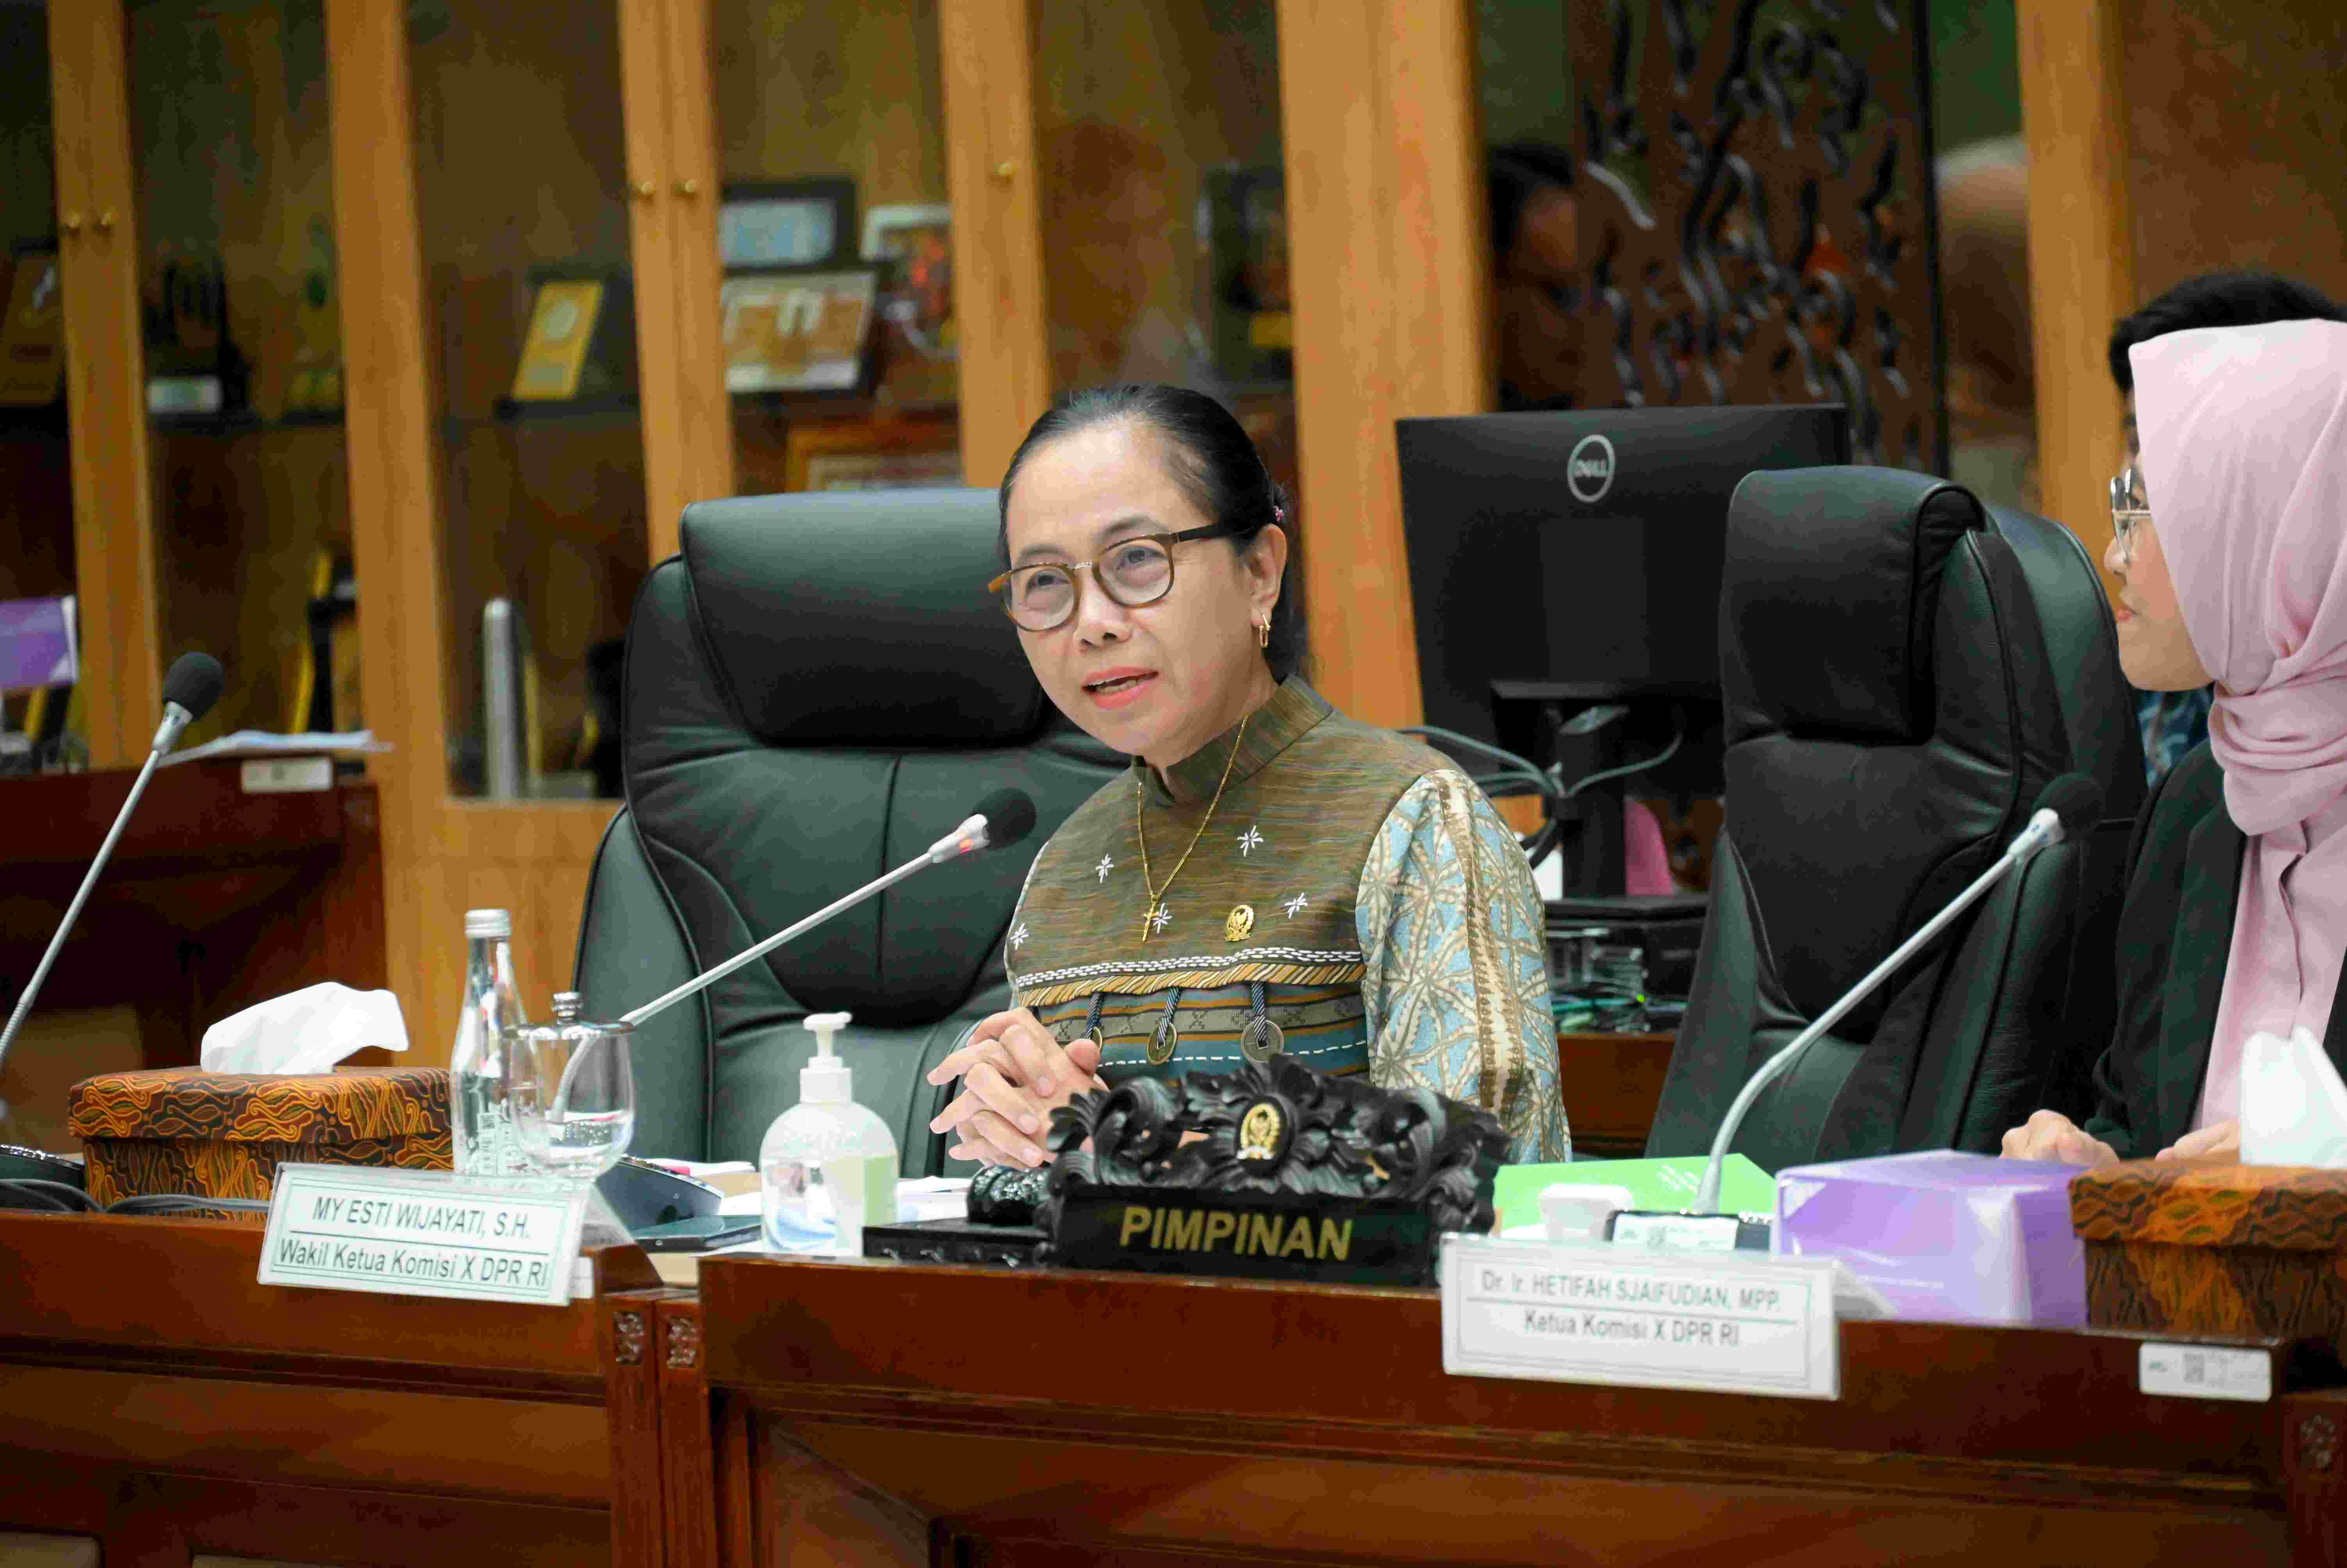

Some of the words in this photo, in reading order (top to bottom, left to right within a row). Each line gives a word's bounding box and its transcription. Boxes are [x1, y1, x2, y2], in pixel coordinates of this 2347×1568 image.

[1574, 459, 1608, 477] DELL
[312, 1196, 345, 1222] MY
[347, 1200, 392, 1228] ESTI
[397, 1203, 485, 1239] WIJAYATI,
[494, 1211, 530, 1237] S.H.
[1120, 1206, 1352, 1261] PIMPINAN
[280, 1238, 329, 1266] Wakil
[332, 1243, 385, 1272] Ketua
[391, 1249, 457, 1278] Komisi
[461, 1255, 476, 1280] X
[481, 1257, 522, 1284] DPR
[527, 1261, 549, 1286] RI
[1532, 1274, 1611, 1299] HETIFAH
[1525, 1309, 1575, 1334] Ketua
[1583, 1312, 1646, 1340] Komisi
[1653, 1319, 1667, 1342] X
[1672, 1319, 1713, 1345] DPR
[1719, 1324, 1739, 1347] RI
